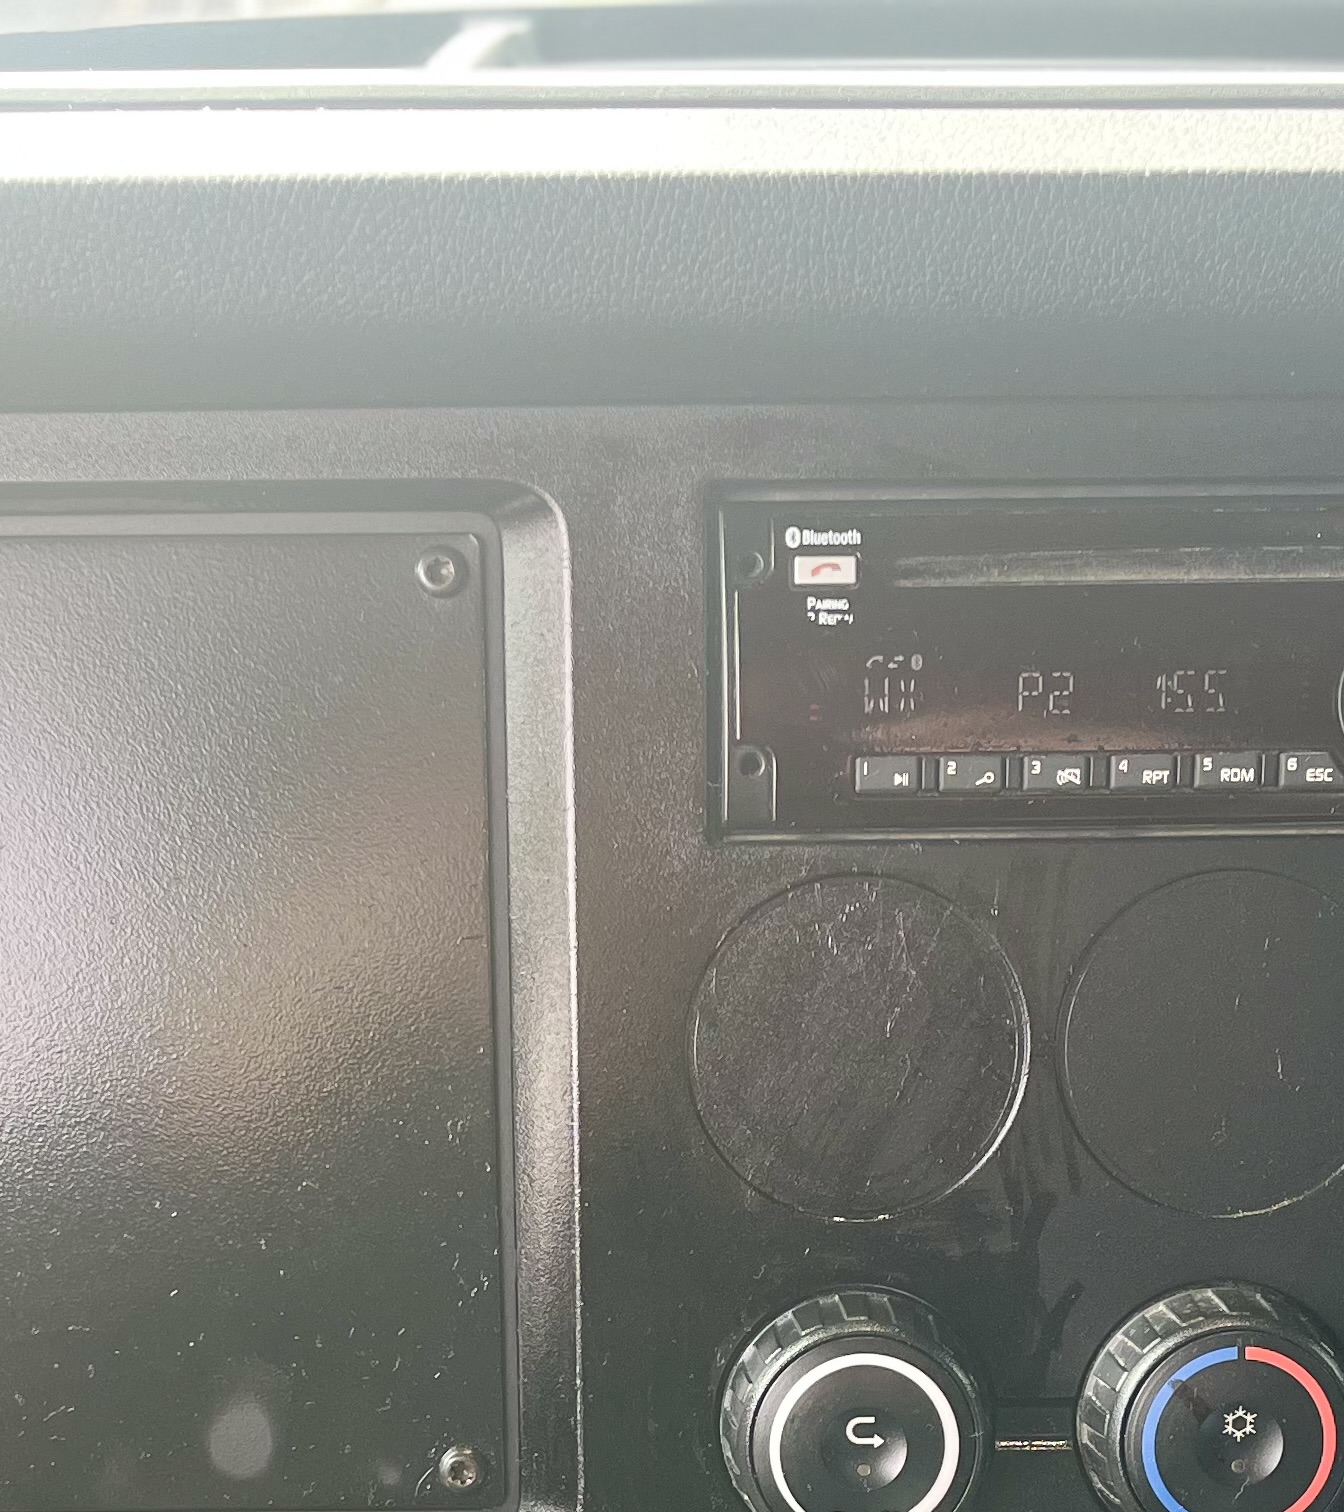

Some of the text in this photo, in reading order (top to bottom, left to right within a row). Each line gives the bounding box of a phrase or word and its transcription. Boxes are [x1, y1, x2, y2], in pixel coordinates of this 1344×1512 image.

[801, 528, 862, 546] Bluetooth
[863, 761, 868, 776] 1
[946, 760, 957, 775] 2
[1031, 760, 1041, 775] 3
[1118, 759, 1129, 773] 4
[1202, 757, 1213, 772] 5
[1287, 757, 1298, 771] 6
[1142, 769, 1170, 785] RPT
[1220, 767, 1255, 783] RDM
[1305, 767, 1334, 782] ESC
